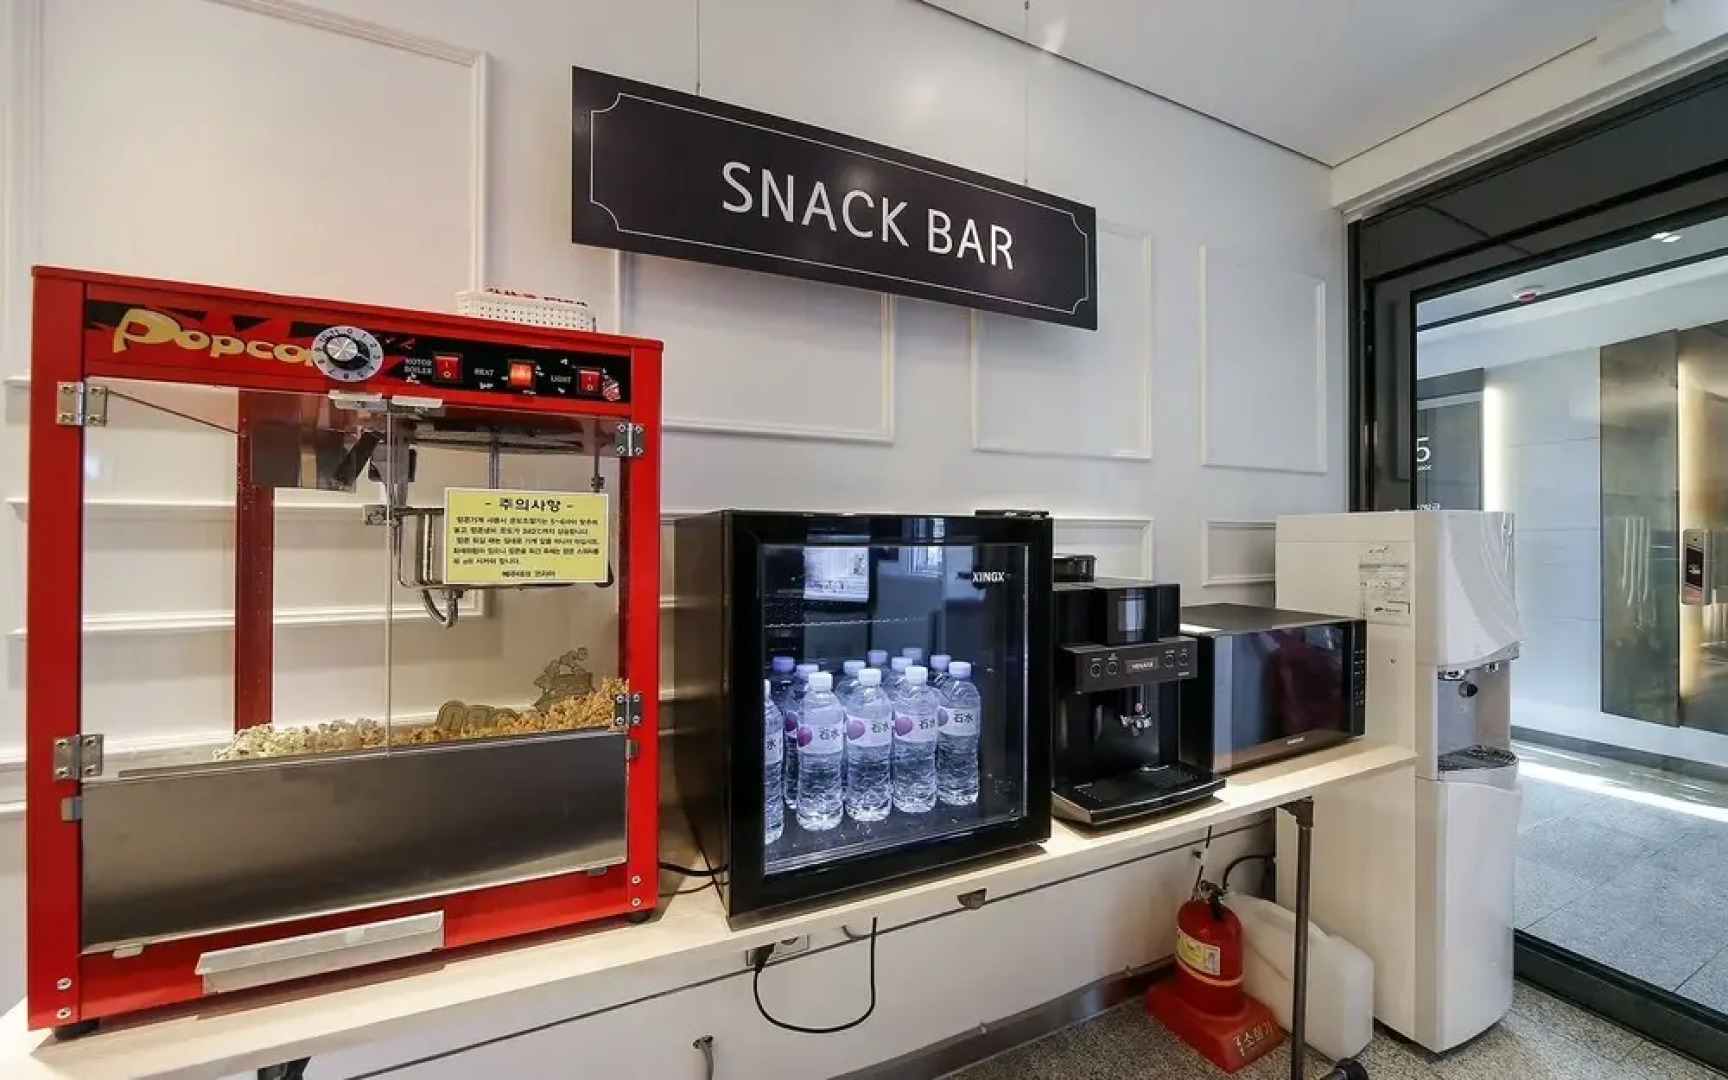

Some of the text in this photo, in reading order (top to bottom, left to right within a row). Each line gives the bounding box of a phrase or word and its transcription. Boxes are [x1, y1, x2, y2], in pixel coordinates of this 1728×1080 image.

[722, 161, 1014, 270] SNACK BAR
[113, 308, 314, 367] Popco
[405, 357, 432, 366] MOTOR
[473, 367, 495, 376] HEAT
[499, 497, 561, 512] 주의사항
[952, 713, 974, 723] 石水
[870, 721, 890, 733] 石水
[819, 728, 840, 740] 石水
